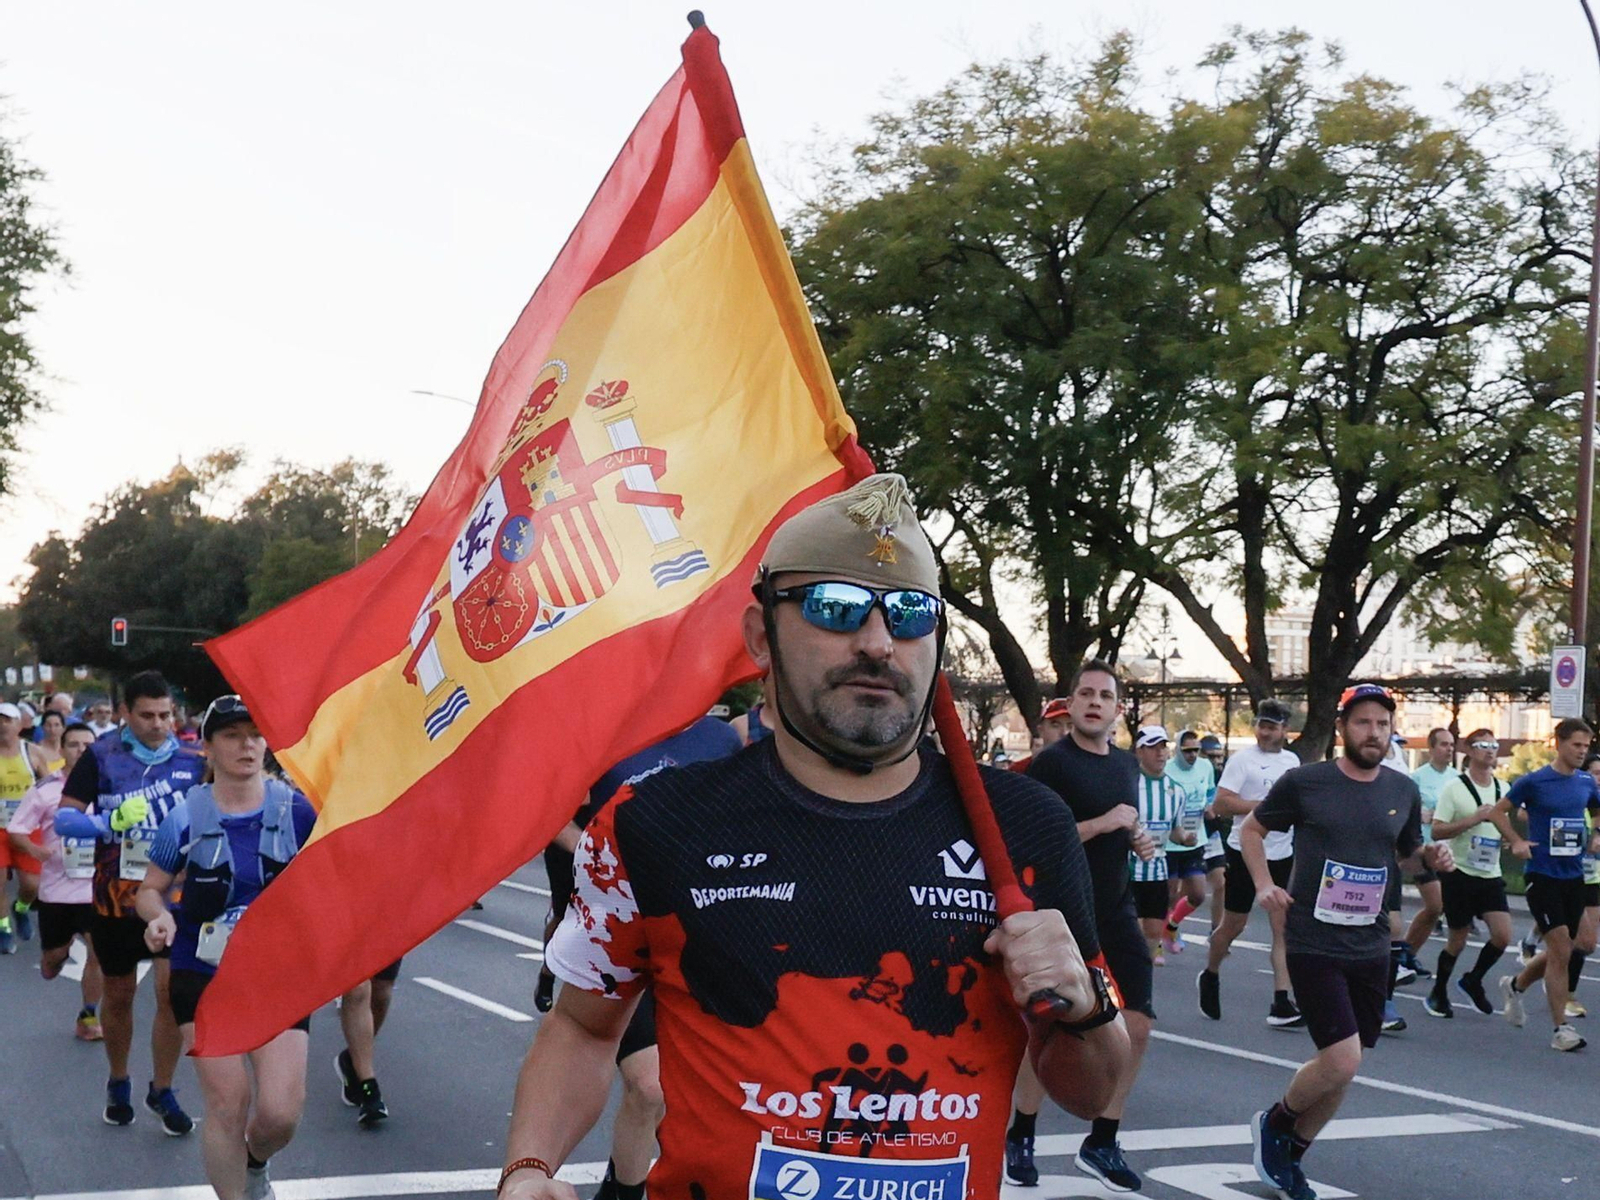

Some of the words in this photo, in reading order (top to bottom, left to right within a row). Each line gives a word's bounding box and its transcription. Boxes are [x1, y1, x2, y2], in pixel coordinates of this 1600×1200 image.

[739, 853, 767, 868] SP
[690, 882, 796, 909] DEPORTEMANIA
[932, 910, 996, 925] consultin
[738, 1081, 823, 1120] Los
[828, 1085, 980, 1123] Lentos
[771, 1125, 822, 1144] CLUB
[826, 1131, 854, 1145] DE
[859, 1130, 957, 1148] ATLETISMO
